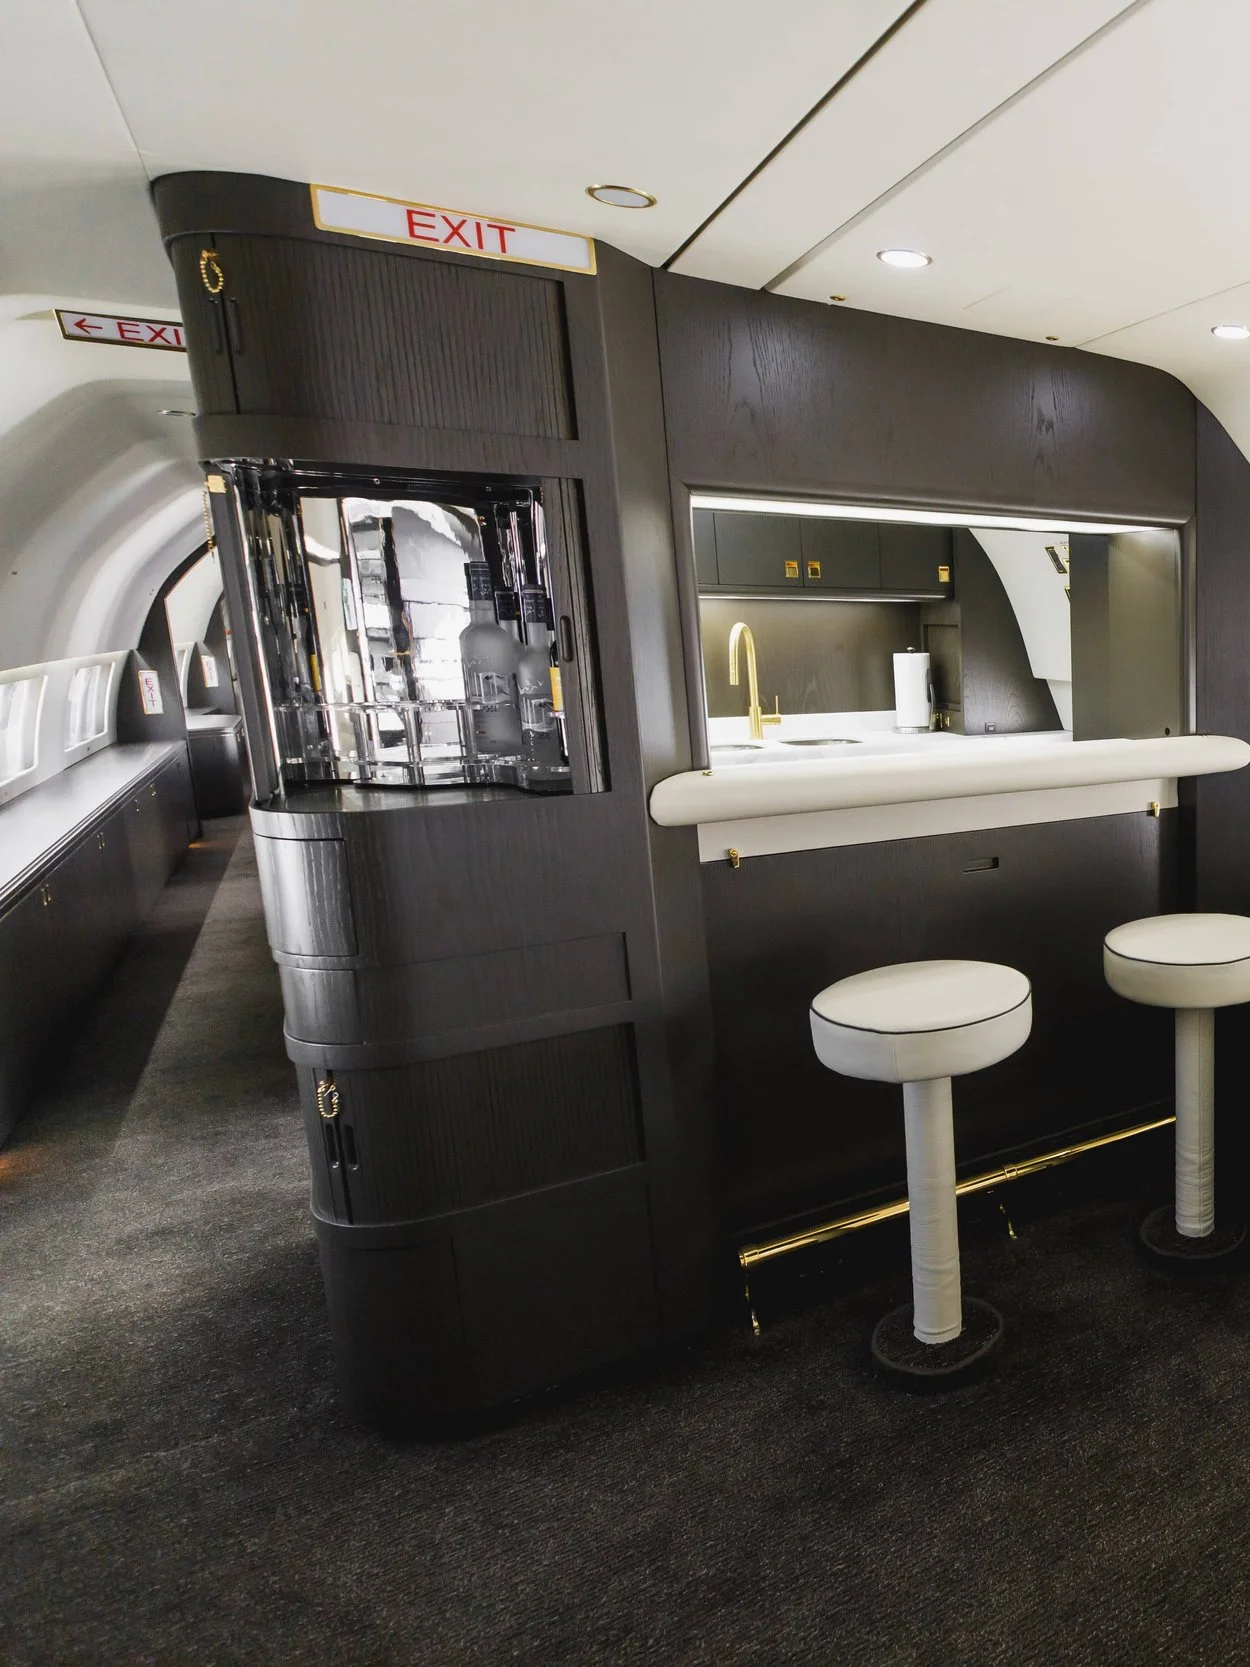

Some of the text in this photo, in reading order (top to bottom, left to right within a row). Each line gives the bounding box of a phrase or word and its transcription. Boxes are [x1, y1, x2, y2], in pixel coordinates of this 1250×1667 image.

[406, 209, 516, 254] EXIT
[116, 321, 182, 346] EXI
[145, 678, 156, 707] EXIT
